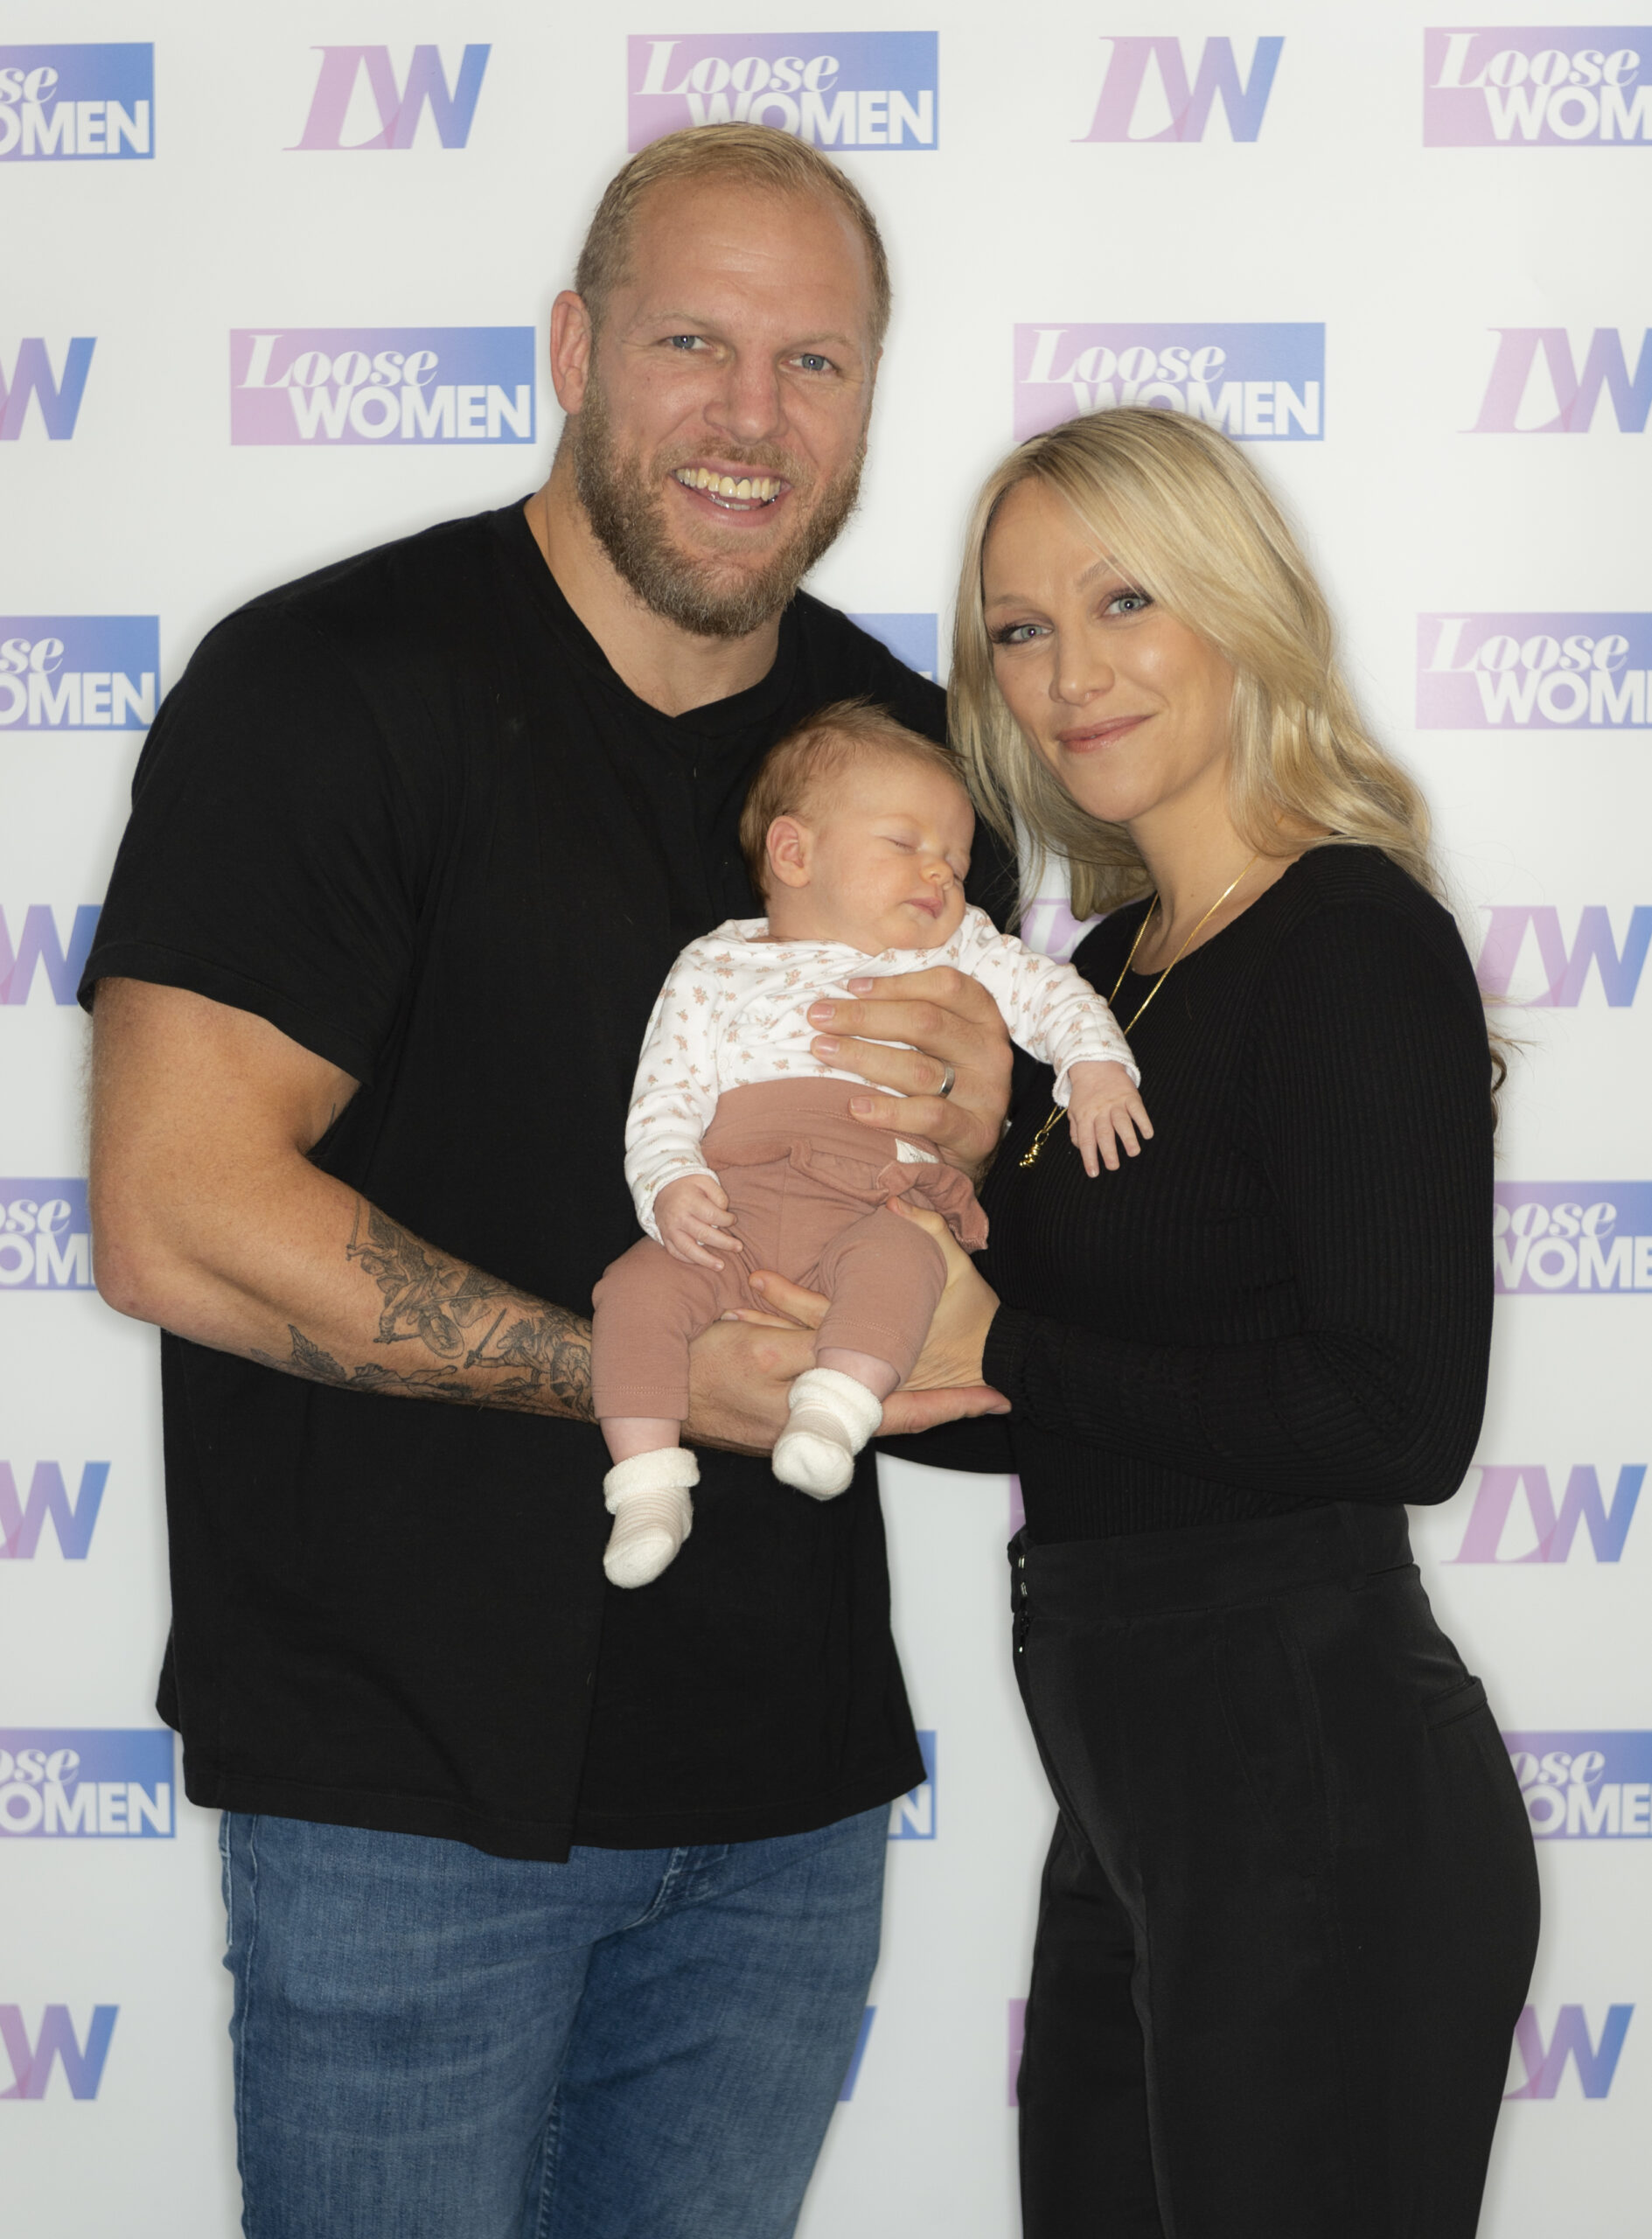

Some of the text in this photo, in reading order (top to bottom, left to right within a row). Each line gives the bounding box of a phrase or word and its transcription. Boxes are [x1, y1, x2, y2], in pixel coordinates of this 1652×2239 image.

[633, 41, 840, 94] Loose
[1429, 33, 1641, 87] Loose
[237, 335, 438, 387] Loose
[1020, 329, 1226, 383] Loose
[288, 385, 531, 438] WOMEN
[1421, 618, 1629, 673] Loose
[1475, 669, 1652, 724] WOM
[0, 1199, 72, 1234] se
[0, 1232, 95, 1286] OM
